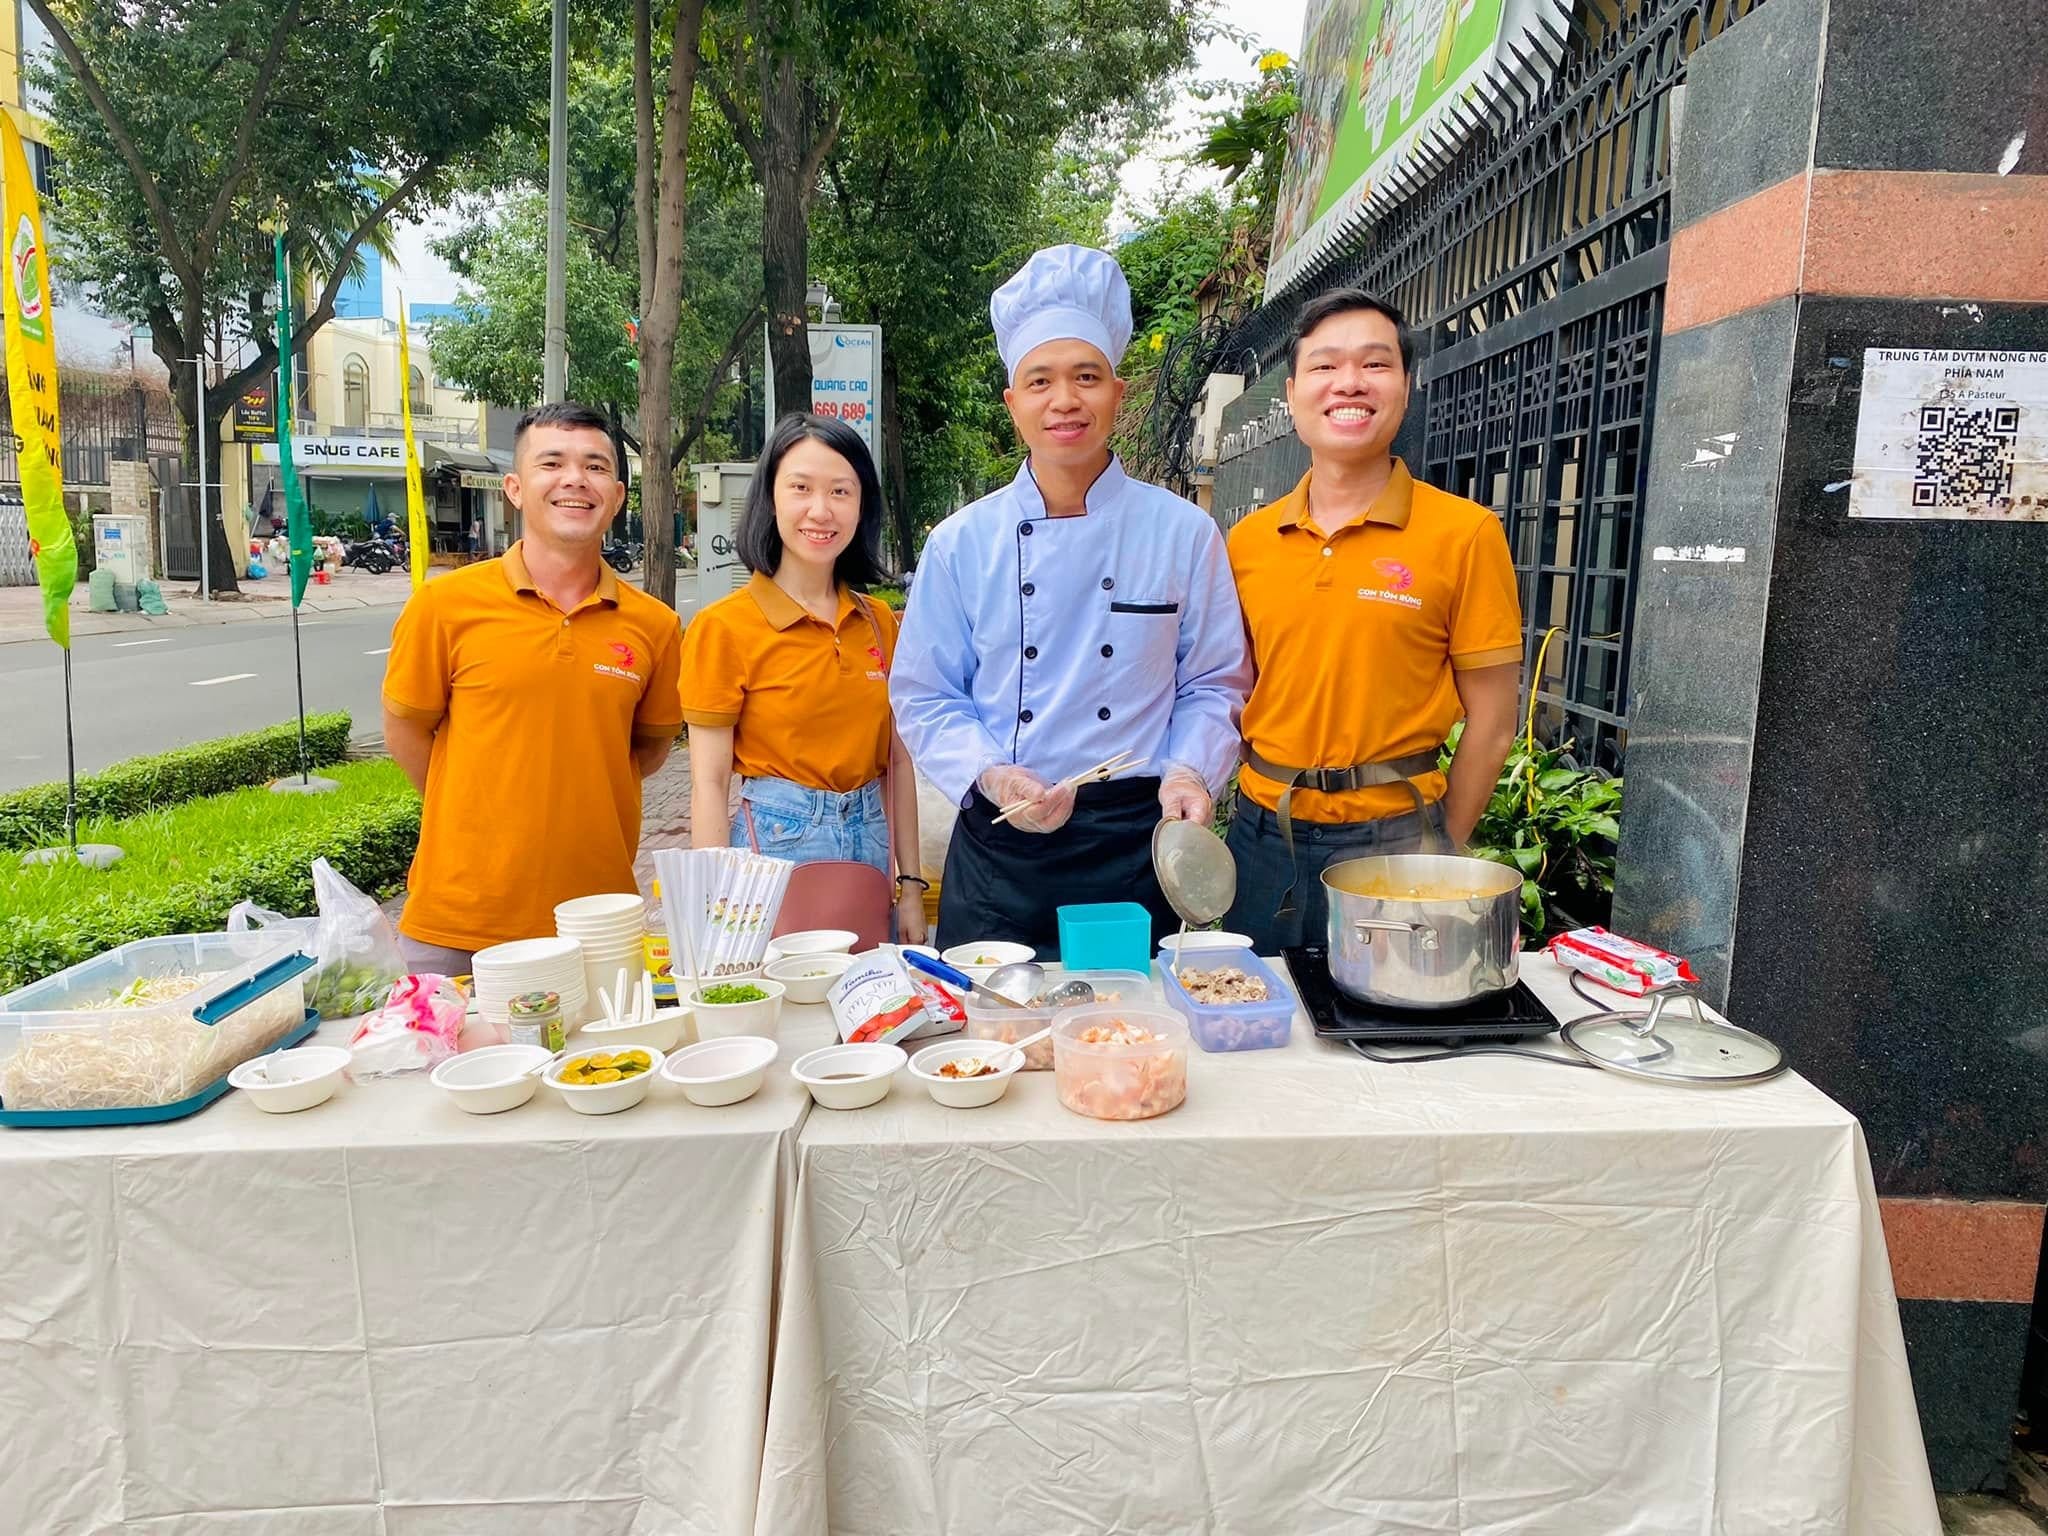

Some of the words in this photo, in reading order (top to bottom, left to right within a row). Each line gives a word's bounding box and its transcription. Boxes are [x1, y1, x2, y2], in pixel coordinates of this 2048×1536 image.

[845, 338, 871, 346] OCEAN
[1879, 351, 1920, 361] TRUNG
[1952, 351, 1986, 362] DVTM
[1944, 366, 1972, 378] PHÍA
[1975, 368, 2004, 379] NAM
[1958, 390, 1965, 399] A
[1967, 390, 2006, 399] Pasteur
[814, 401, 838, 418] 669
[842, 402, 866, 420] 689
[304, 444, 350, 456] SNUG
[357, 446, 400, 458] CAFE
